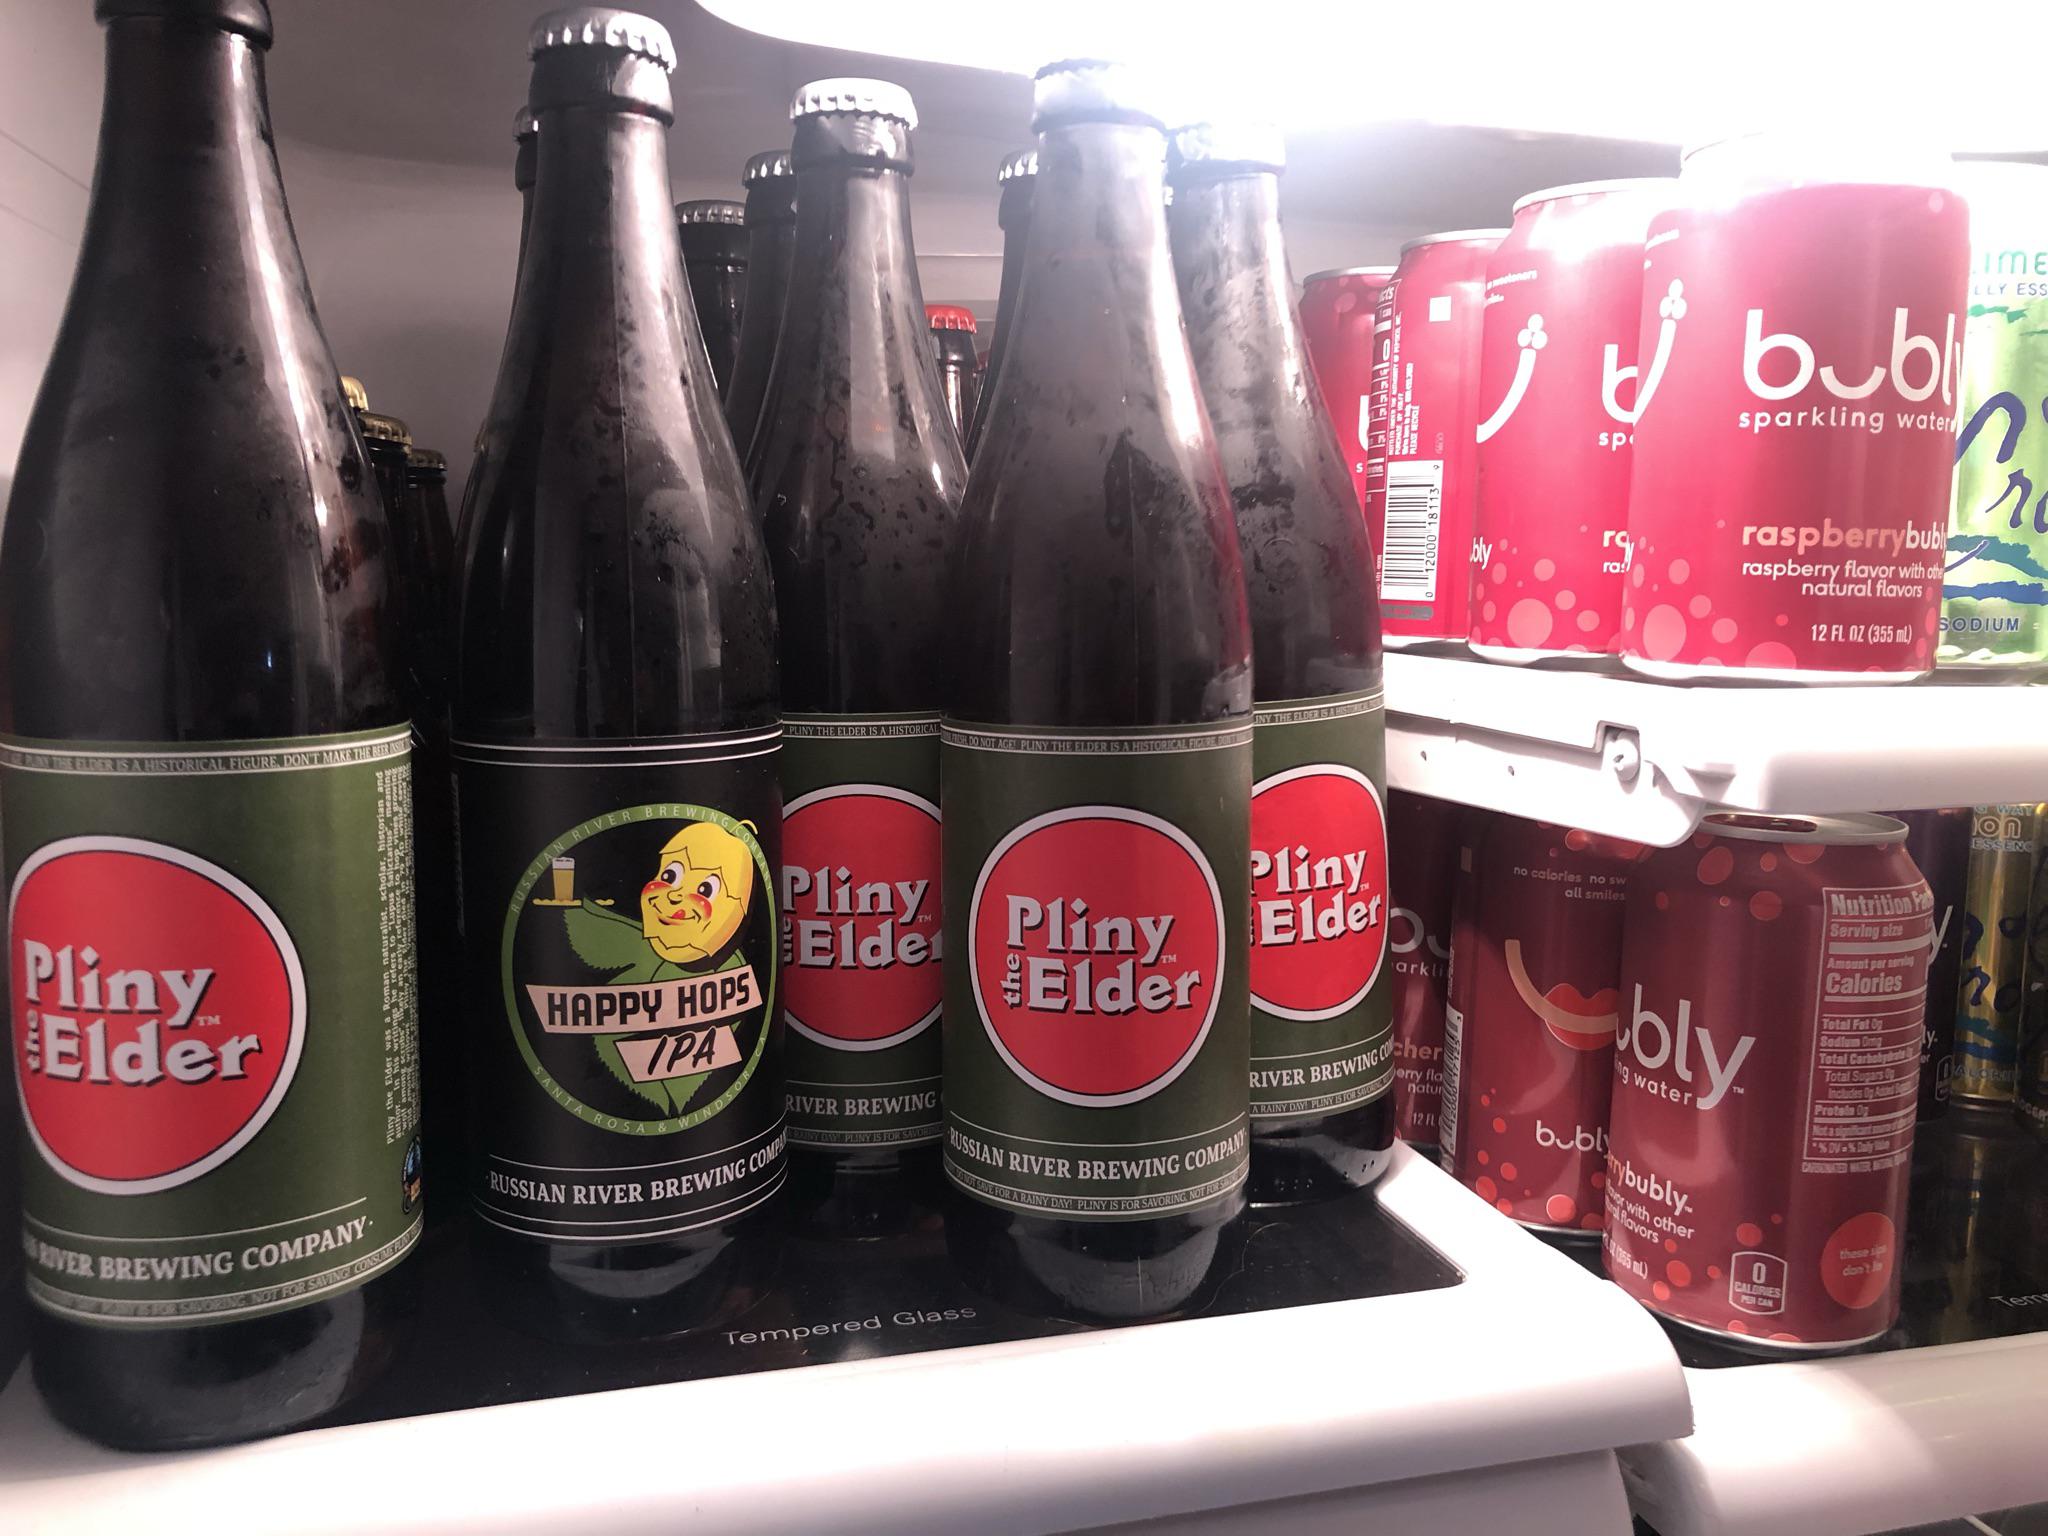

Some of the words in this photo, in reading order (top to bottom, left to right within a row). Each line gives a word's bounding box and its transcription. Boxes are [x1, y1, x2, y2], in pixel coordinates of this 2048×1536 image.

[1983, 250, 2048, 276] IME
[1738, 405, 1885, 434] sparkling
[1896, 409, 1950, 432] water
[1428, 488, 1440, 526] 18113
[1425, 534, 1437, 573] 12000
[1741, 558, 1841, 584] raspberry
[1844, 560, 1896, 580] flavor
[1899, 562, 1926, 580] with
[1801, 578, 1873, 597] natural
[1876, 579, 1923, 598] flavors
[1811, 624, 1828, 642] 12
[1830, 624, 1845, 642] FL
[1849, 624, 1865, 642] OZ
[1867, 624, 1894, 644] (355
[1939, 616, 2020, 632] SODIUM
[789, 726, 815, 737] PLINY
[817, 726, 836, 737] THE
[837, 726, 866, 737] ELDER
[869, 726, 879, 737] IS
[880, 725, 888, 736] A
[889, 723, 939, 736] HISTORICAL
[1274, 713, 1293, 723] THE
[1294, 710, 1319, 721] ELDER
[115, 759, 129, 772] IS
[131, 759, 142, 772] A
[144, 757, 225, 772] HISTORICAL
[283, 751, 320, 768] DON'T
[322, 749, 352, 764] MAKE
[353, 747, 371, 762] THE
[980, 737, 997, 748] NOT
[1021, 740, 1049, 751] PLINY
[1052, 741, 1073, 751] THE
[1075, 741, 1107, 752] ELDER
[1110, 743, 1120, 753] IS
[1122, 743, 1132, 753] A
[1132, 739, 1189, 752] HISTORICAL
[375, 771, 384, 793] and
[377, 799, 386, 852] historian
[511, 841, 566, 914] RUSSIAN
[571, 811, 632, 841] RIVER
[645, 805, 730, 828] BREWING
[1971, 838, 2033, 853] ESSENC
[1250, 844, 1367, 895] Pliny
[1513, 866, 1528, 876] no
[1530, 868, 1582, 883] calories
[1589, 875, 1606, 885] no
[783, 865, 930, 925] Pliny
[1564, 886, 1582, 898] all
[1830, 893, 1913, 917] Nutrition
[1006, 894, 1175, 967] Pliny
[1257, 890, 1381, 946] Elder
[1830, 923, 1880, 940] Serving
[1882, 922, 1904, 937] size
[24, 939, 214, 1028] Pliny
[382, 971, 391, 1011] Roman
[1000, 952, 1022, 1008] the
[1026, 956, 1201, 1015] Elder
[1825, 971, 1903, 995] Calories
[547, 988, 663, 1027] HAPPY
[677, 971, 750, 1020] HOPS
[1822, 1018, 1850, 1030] Total
[41, 1012, 262, 1087] Elder
[384, 1029, 392, 1051] was
[646, 1025, 718, 1076] IPA
[384, 1056, 394, 1086] Elder
[392, 1056, 401, 1072] his
[1250, 1068, 1306, 1088] RIVER
[1310, 1049, 1378, 1083] BREWING
[1825, 1070, 1849, 1082] Total
[385, 1091, 394, 1110] the
[533, 1066, 583, 1115] SANTA
[593, 1112, 645, 1134] ROSA
[785, 1094, 839, 1116] RIVER
[844, 1091, 937, 1116] BREWING
[1633, 1072, 1694, 1106] water
[1252, 1104, 1259, 1114] A
[1260, 1103, 1287, 1114] RAINY
[1289, 1100, 1309, 1112] DAY!
[1311, 1096, 1334, 1109] PLINY
[1335, 1095, 1343, 1105] IS
[386, 1115, 396, 1145] Pliny
[949, 1125, 1005, 1168] RUSSIAN
[1009, 1151, 1072, 1179] RIVER
[1077, 1154, 1181, 1181] BREWING
[1184, 1127, 1246, 1171] COMPANY
[489, 1170, 567, 1204] RUSSIAN
[572, 1183, 644, 1205] RIVER
[650, 1158, 746, 1201] BREWING
[976, 1178, 995, 1195] SAVE
[995, 1186, 1011, 1199] FOR
[1012, 1190, 1020, 1201] A
[1020, 1192, 1050, 1207] RAINY
[1051, 1197, 1074, 1209] DAY!
[1077, 1199, 1108, 1210] PLINY
[1110, 1200, 1119, 1210] IS
[1121, 1199, 1141, 1210] FOR
[1142, 1192, 1187, 1209] SAVORING,
[1189, 1186, 1206, 1199] NOT
[1206, 1182, 1220, 1195] FOR
[1625, 1199, 1651, 1224] with
[1653, 1215, 1696, 1240] other
[38, 1241, 95, 1279] RIVER
[99, 1250, 235, 1281] BREWING
[241, 1215, 368, 1271] COMPANY
[1752, 1262, 1767, 1285] 0
[281, 1280, 306, 1298] FOR
[1734, 1281, 1782, 1299] CALORIES
[720, 1315, 883, 1347] Tempered
[892, 1306, 977, 1327] Glass
